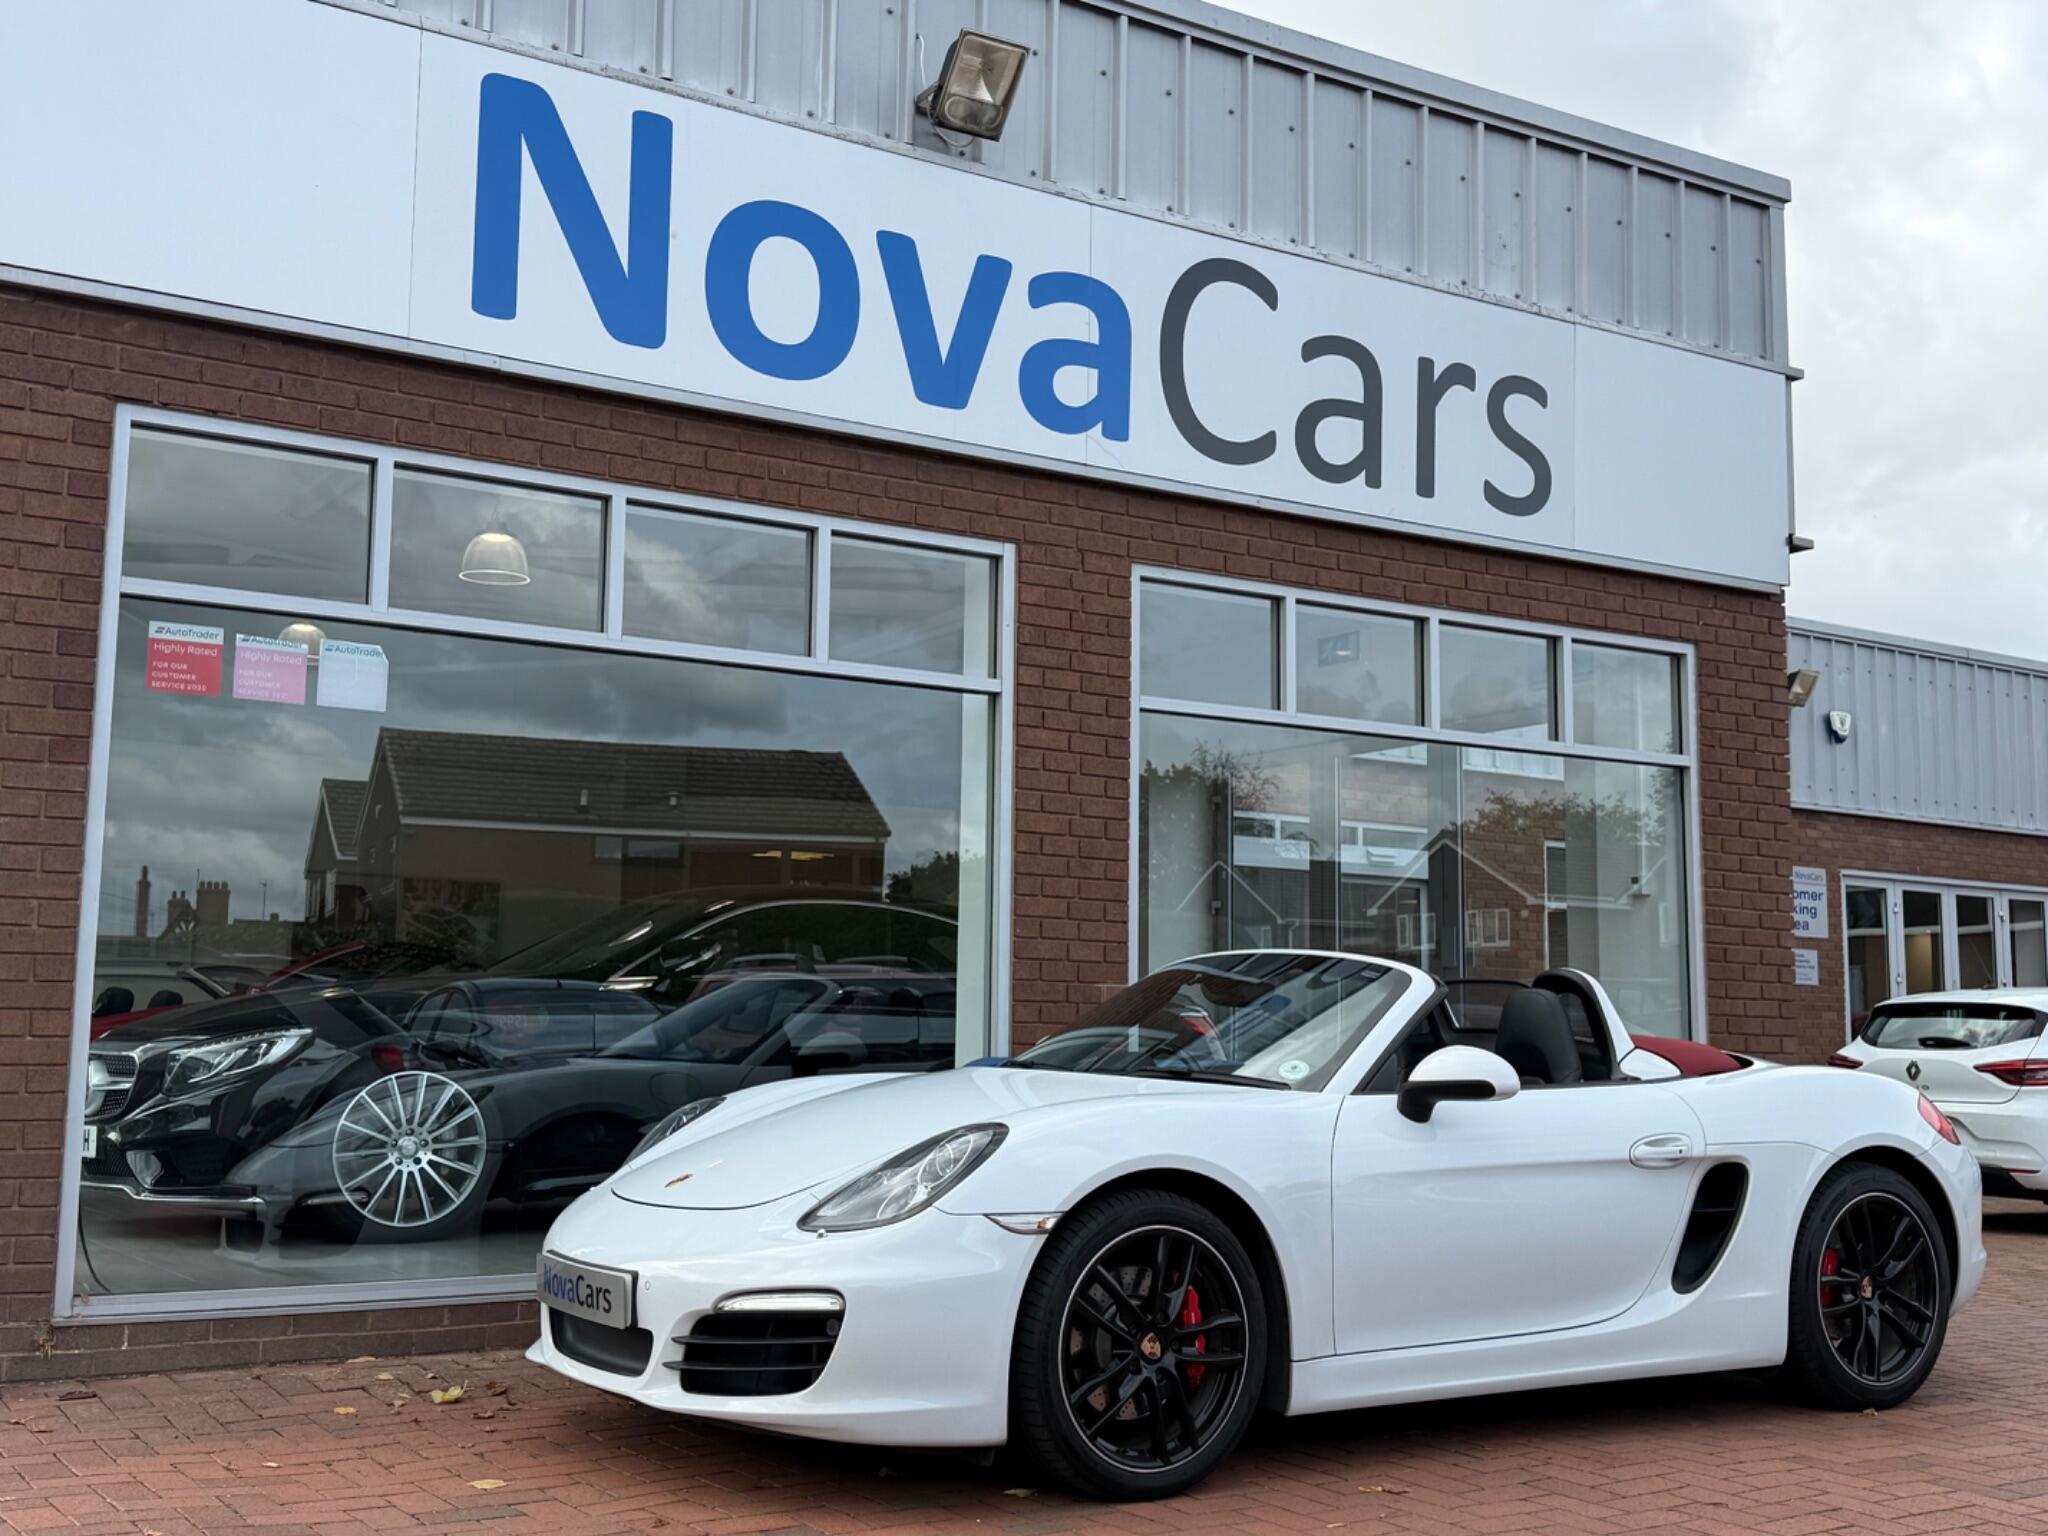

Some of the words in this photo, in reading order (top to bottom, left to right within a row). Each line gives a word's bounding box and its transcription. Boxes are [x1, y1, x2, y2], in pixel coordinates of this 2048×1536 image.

[471, 73, 1552, 518] NovaCars
[165, 626, 219, 640] AutoTrader
[154, 642, 185, 655] Highly
[187, 645, 218, 656] Rated
[240, 650, 271, 662] Highly
[273, 654, 302, 665] Rated
[153, 661, 169, 669] FOR
[170, 662, 188, 670] OUR
[152, 670, 197, 680] CUSTOMER
[152, 680, 185, 690] SERVICE
[543, 1263, 612, 1314] NovaCars
